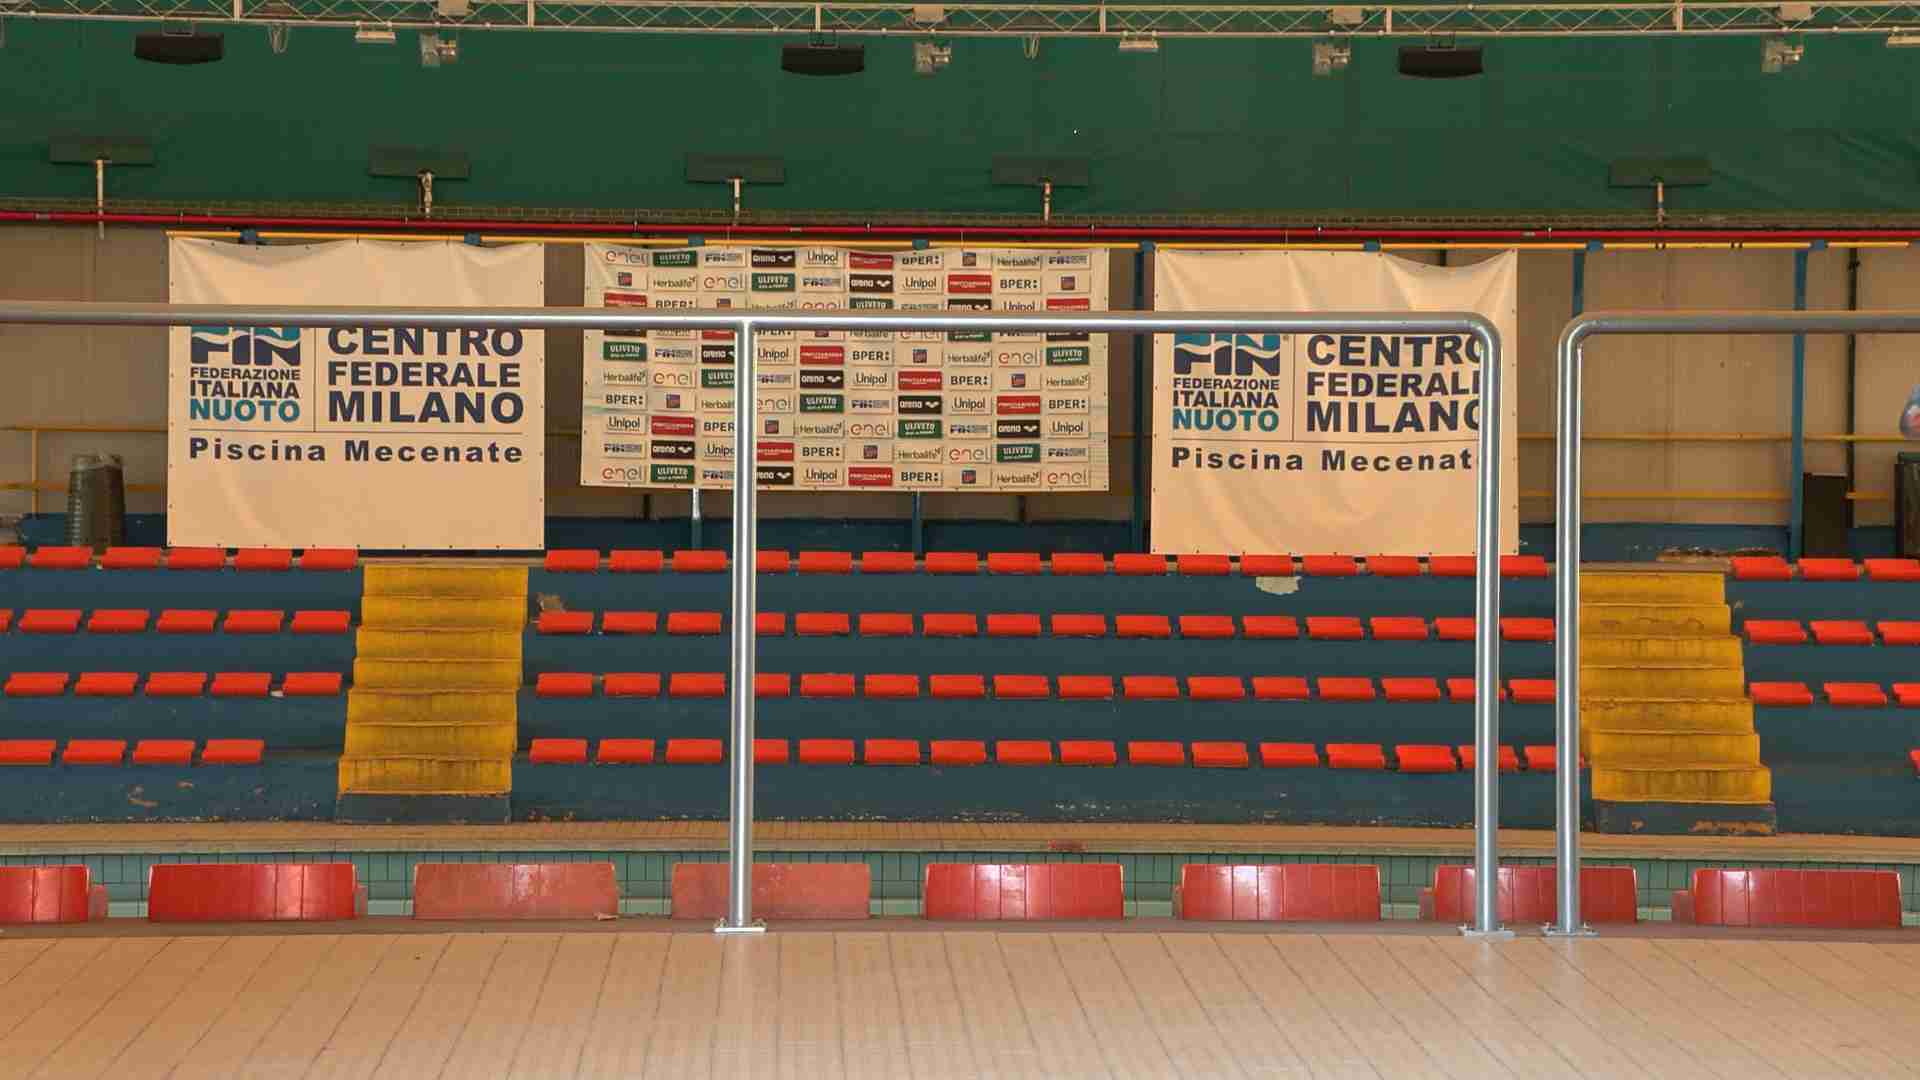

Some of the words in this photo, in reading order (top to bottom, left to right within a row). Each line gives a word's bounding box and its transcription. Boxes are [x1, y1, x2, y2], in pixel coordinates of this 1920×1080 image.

[704, 275, 742, 289] enel
[851, 279, 874, 288] arena
[905, 277, 936, 290] Unipol
[191, 327, 301, 366] FIN
[328, 327, 523, 356] CENTRO
[758, 347, 789, 361] Unipol
[999, 352, 1037, 364] enel
[1173, 334, 1280, 376] FIN
[190, 367, 301, 380] FEDERAZIONE
[328, 362, 521, 387] FEDERALE
[654, 372, 692, 385] enel
[801, 375, 824, 383] arena
[856, 373, 887, 386] Unipol
[190, 380, 300, 399] ITALIANA
[1173, 377, 1280, 390] FEDERAZIONE
[606, 394, 643, 405] BPER:
[900, 400, 922, 409] arena
[953, 397, 985, 411] Unipol
[1173, 391, 1279, 408] ITALIANA
[190, 399, 300, 422] NUOTO
[328, 391, 524, 424] MILANO
[608, 416, 640, 429] Unipol
[704, 422, 735, 432] BPER
[1052, 420, 1083, 434] Unipol
[1172, 409, 1279, 432] NUOTO
[801, 424, 838, 434] Herbalife
[851, 423, 889, 435] enel
[998, 425, 1021, 433] arena
[189, 437, 326, 461] Piscina
[345, 440, 523, 463] Mecenate
[652, 445, 676, 454] arena
[802, 447, 840, 456] BPER:
[899, 449, 937, 459] Herbalife
[950, 448, 989, 461] enel
[1171, 447, 1303, 471] Piscina
[1322, 450, 1472, 471] Mecenat
[602, 466, 641, 480] enel
[806, 468, 838, 481] Unipol
[901, 471, 938, 482] BPER:
[998, 473, 1035, 484] Herbalife
[1048, 471, 1087, 484] enel
